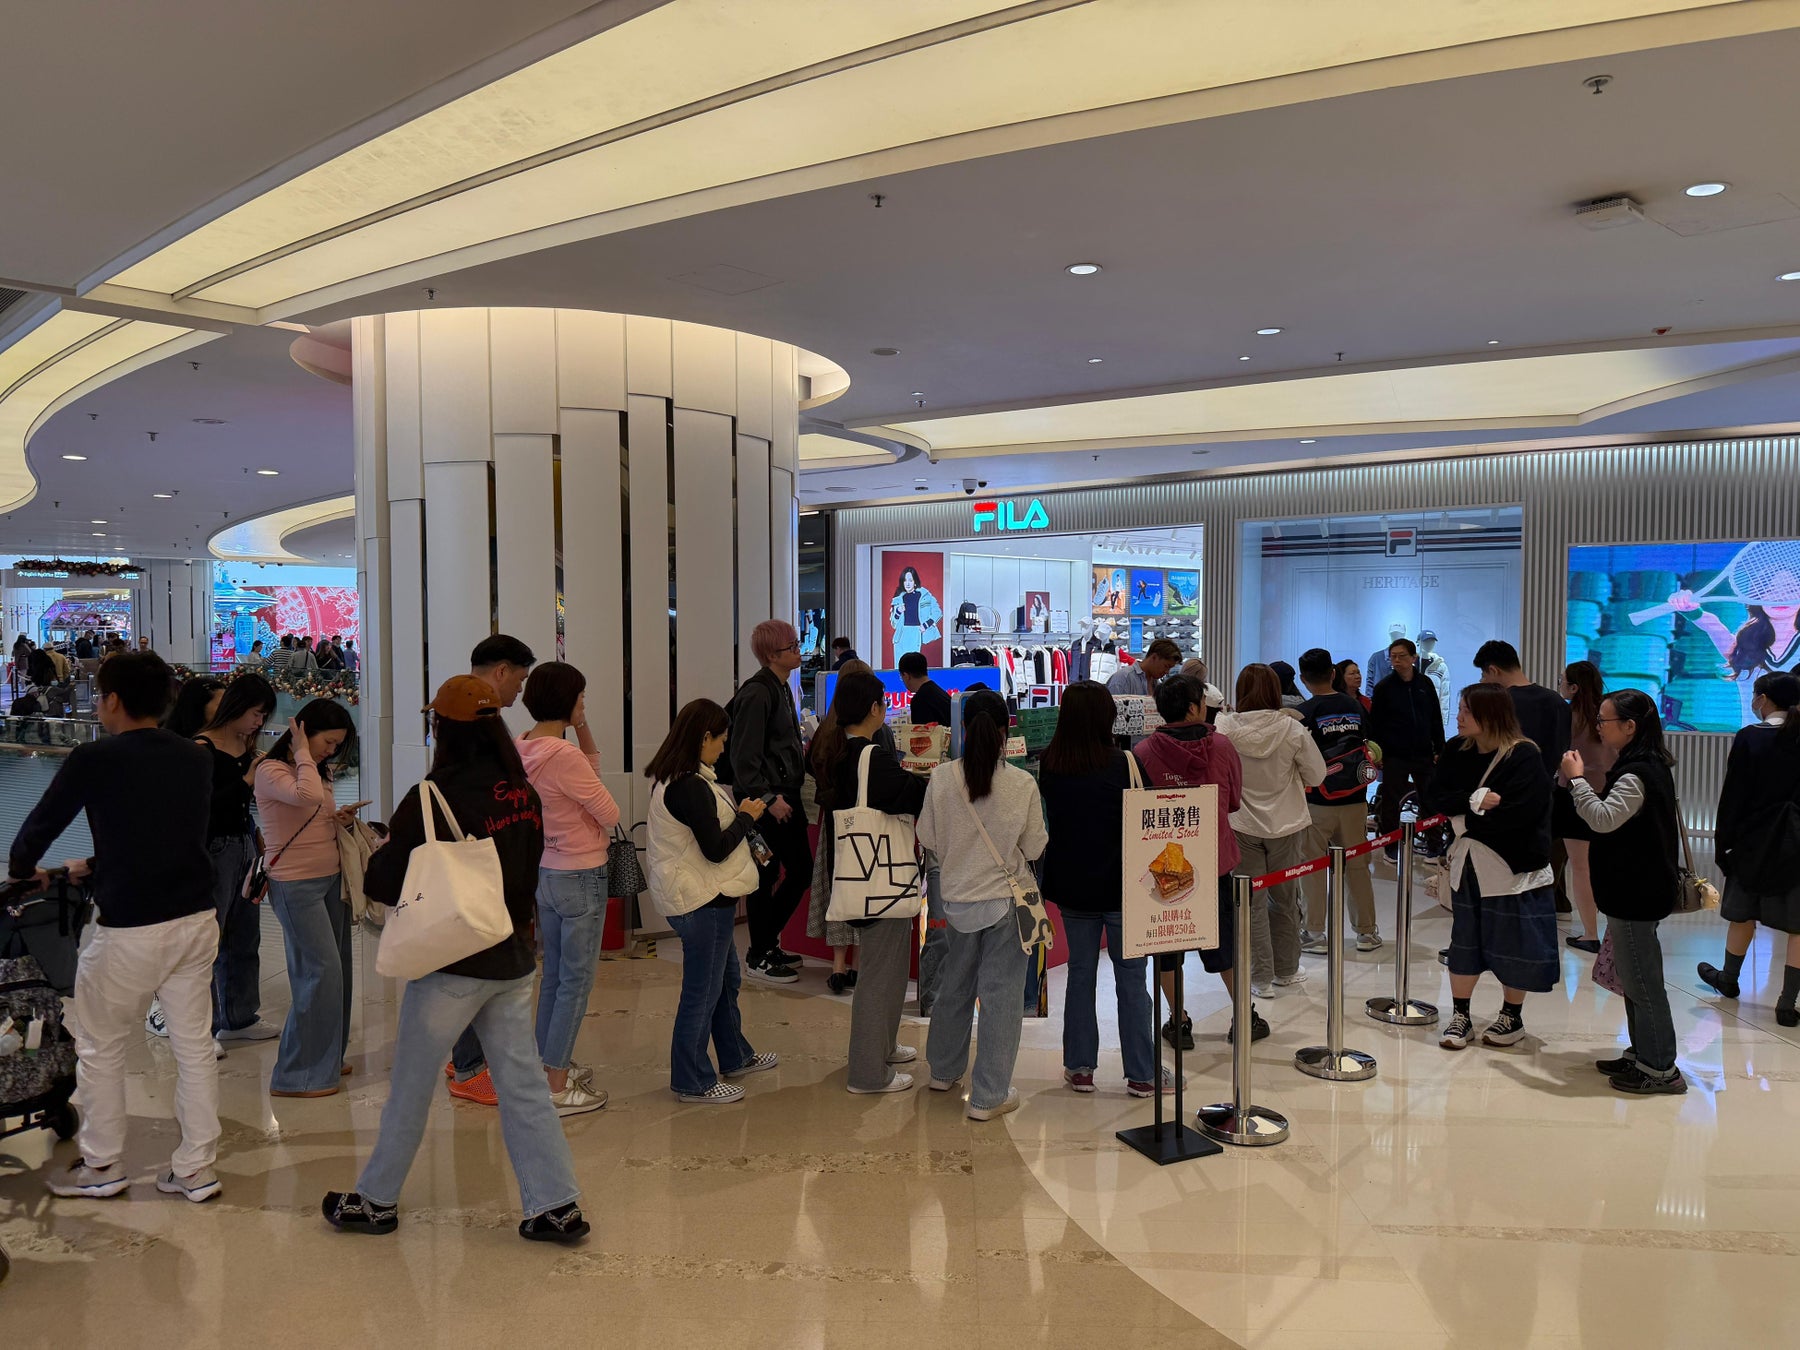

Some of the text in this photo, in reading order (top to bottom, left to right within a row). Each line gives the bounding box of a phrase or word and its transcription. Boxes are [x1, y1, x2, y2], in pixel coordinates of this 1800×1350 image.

[973, 499, 1049, 532] FILA
[1362, 576, 1439, 589] HERITAGE
[1163, 773, 1182, 782] Tog
[1142, 806, 1200, 830] 限量發售
[1142, 827, 1200, 841] Limited Stock
